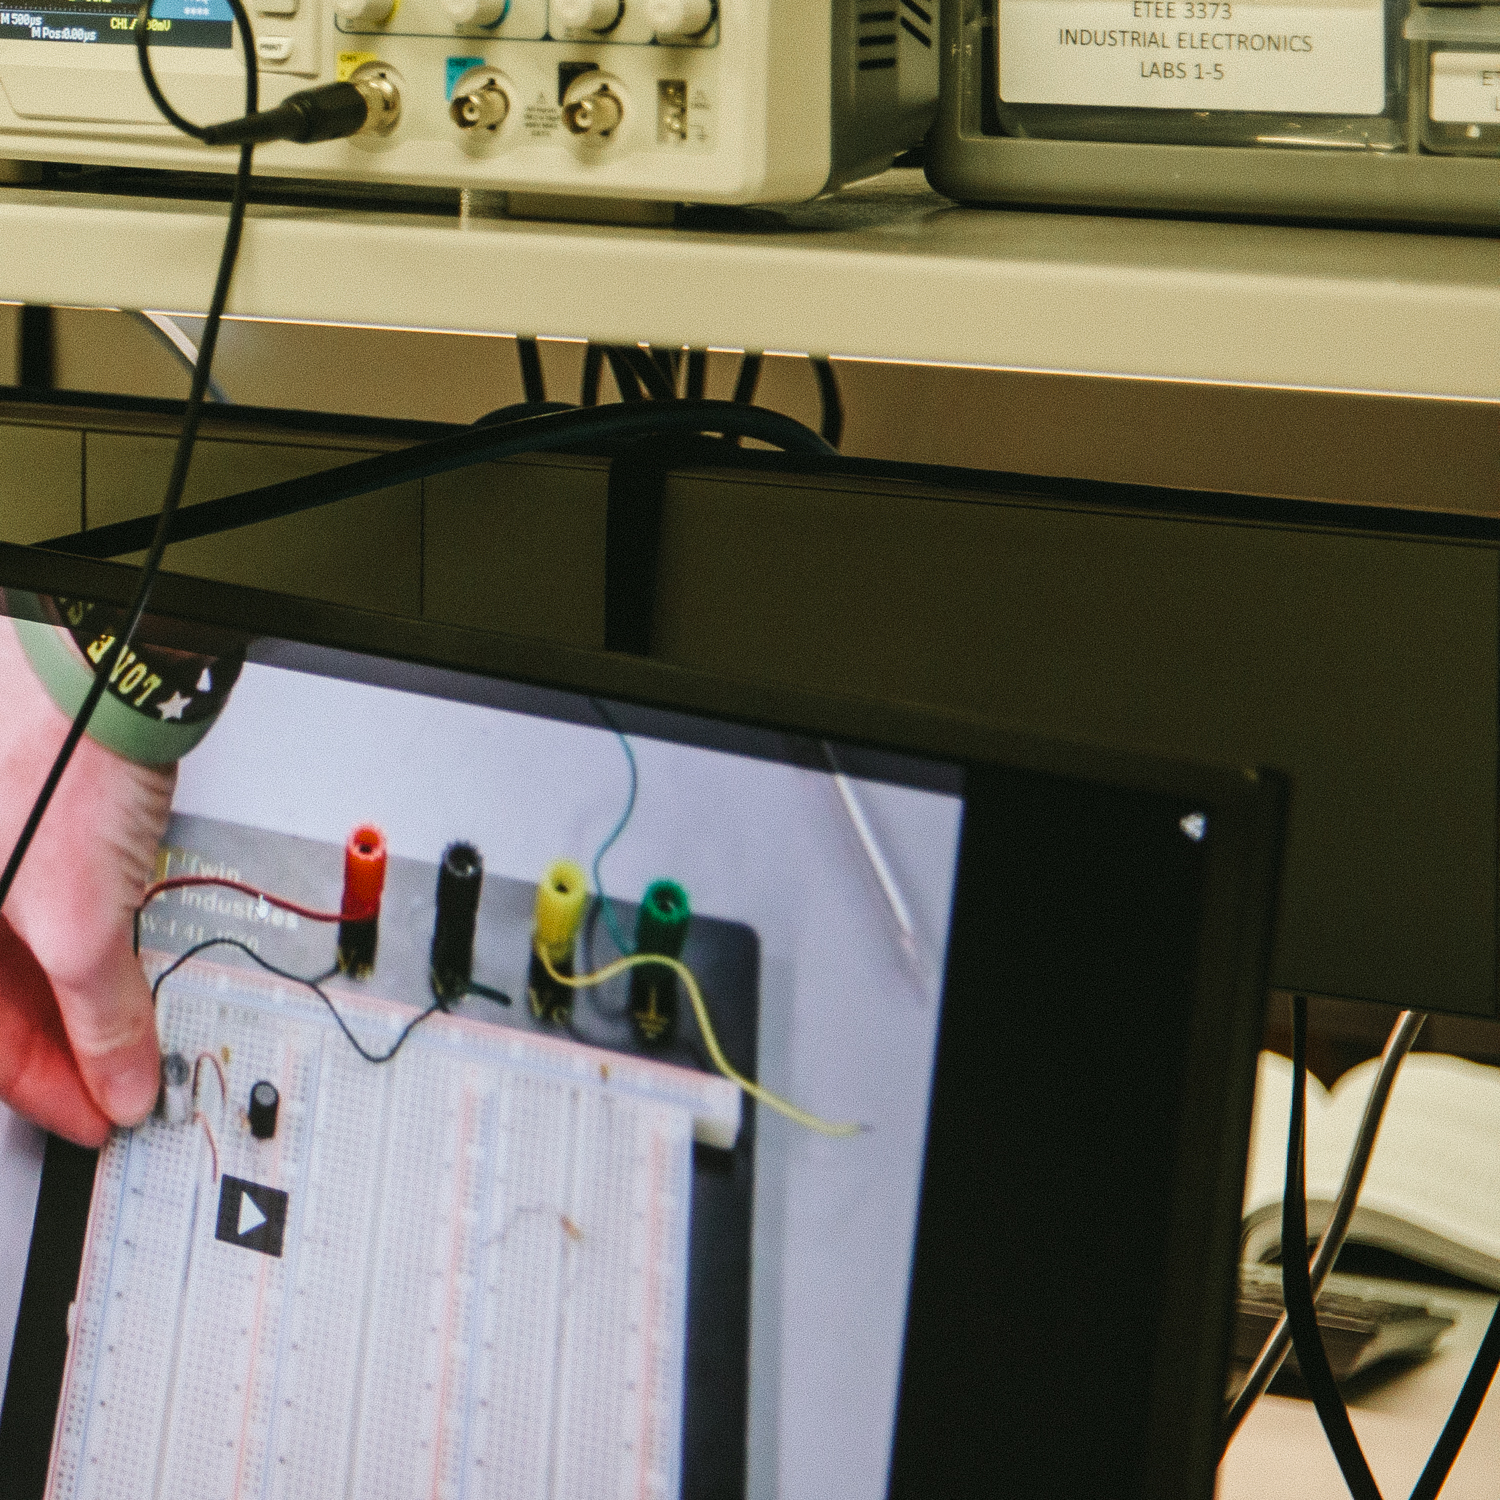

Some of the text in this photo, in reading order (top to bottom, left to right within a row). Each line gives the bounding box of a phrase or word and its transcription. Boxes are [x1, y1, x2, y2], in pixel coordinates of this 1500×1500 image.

[0, 12, 10, 25] M
[1132, 0, 1233, 21] ETEE 3373
[31, 26, 42, 39] M
[1058, 28, 1314, 53] INDUSTRIAL ELECTRONICS
[1139, 60, 1226, 81] LABS 1-5
